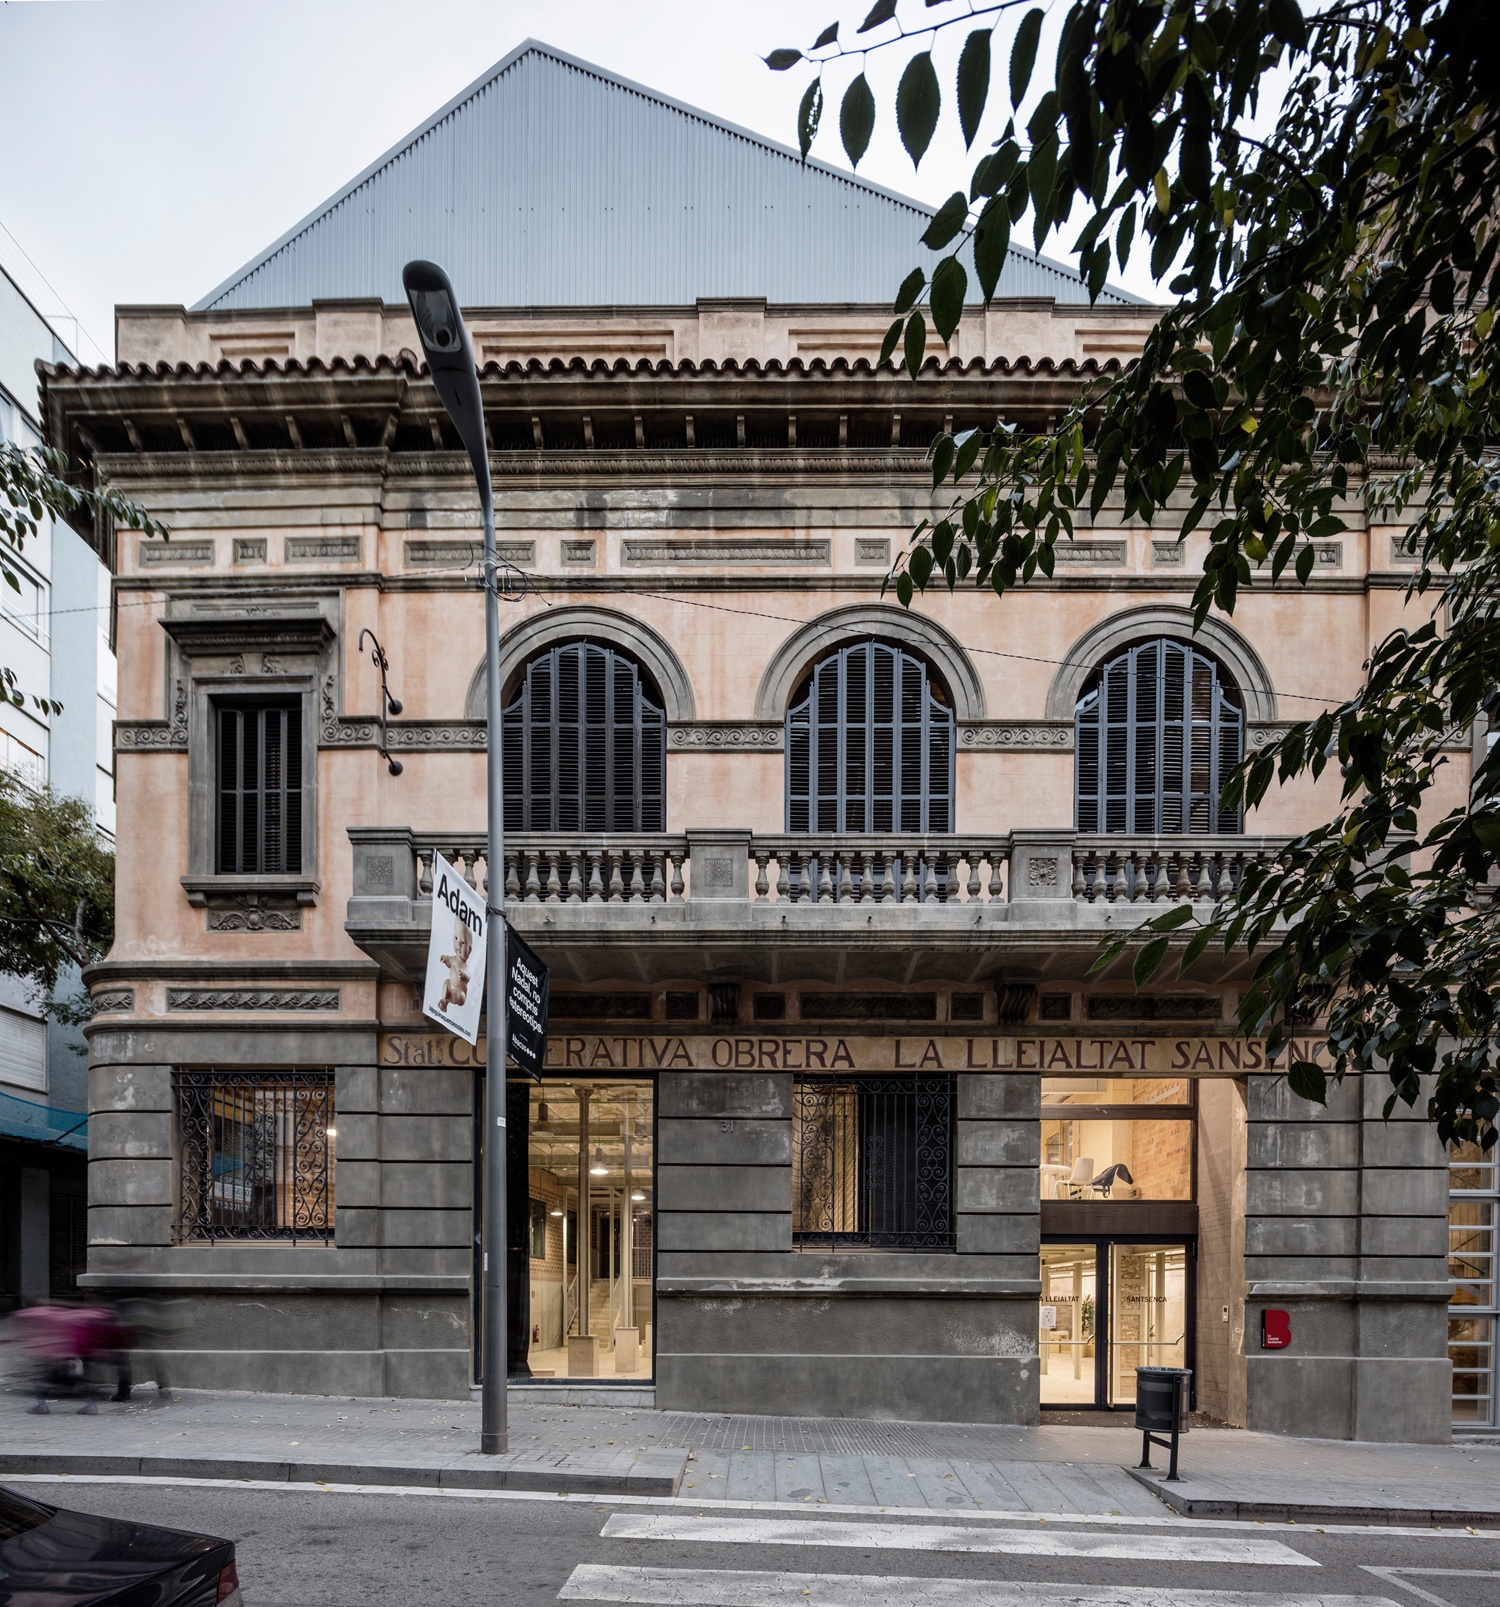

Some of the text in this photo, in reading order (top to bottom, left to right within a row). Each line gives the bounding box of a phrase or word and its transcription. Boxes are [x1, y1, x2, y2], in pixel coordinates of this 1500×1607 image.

[437, 873, 482, 937] Adam
[511, 966, 541, 1004] Nadal, no
[516, 956, 539, 988] Aquest
[509, 996, 544, 1034] estereotips.
[512, 987, 538, 1016] compris
[448, 1036, 694, 1068] COERATIVA
[711, 1037, 856, 1069] OBRERA
[895, 1038, 945, 1069] LA
[966, 1039, 1155, 1070] LLEIALTAT
[1171, 1040, 1357, 1070] SANSNC
[720, 1120, 734, 1133] 31
